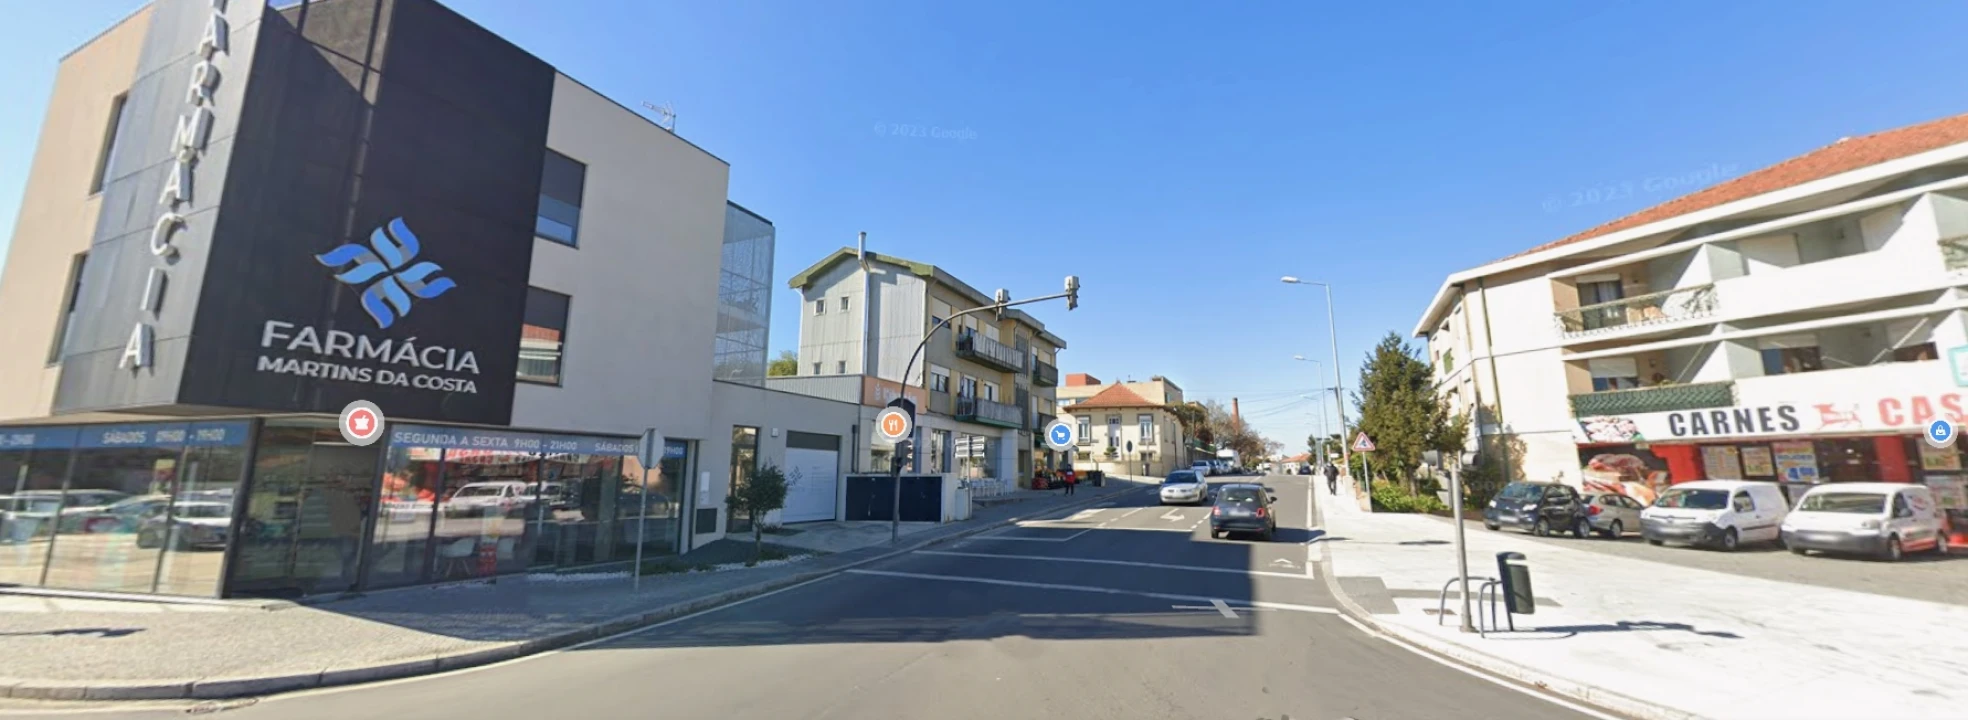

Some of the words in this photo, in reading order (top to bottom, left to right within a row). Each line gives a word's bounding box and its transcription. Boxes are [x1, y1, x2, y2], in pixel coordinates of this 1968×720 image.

[261, 319, 480, 374] FARMÁCIA
[257, 355, 372, 383] MARTINS
[375, 369, 410, 387] DA
[412, 373, 478, 394] COSTA
[1668, 404, 1801, 437] CARNES
[392, 431, 457, 446] SEGUNDA
[459, 436, 470, 446] A
[472, 436, 509, 448] SEXTA
[514, 437, 541, 450] 9H00
[549, 441, 578, 451] 21H00
[595, 441, 635, 453] SÁBADOS
